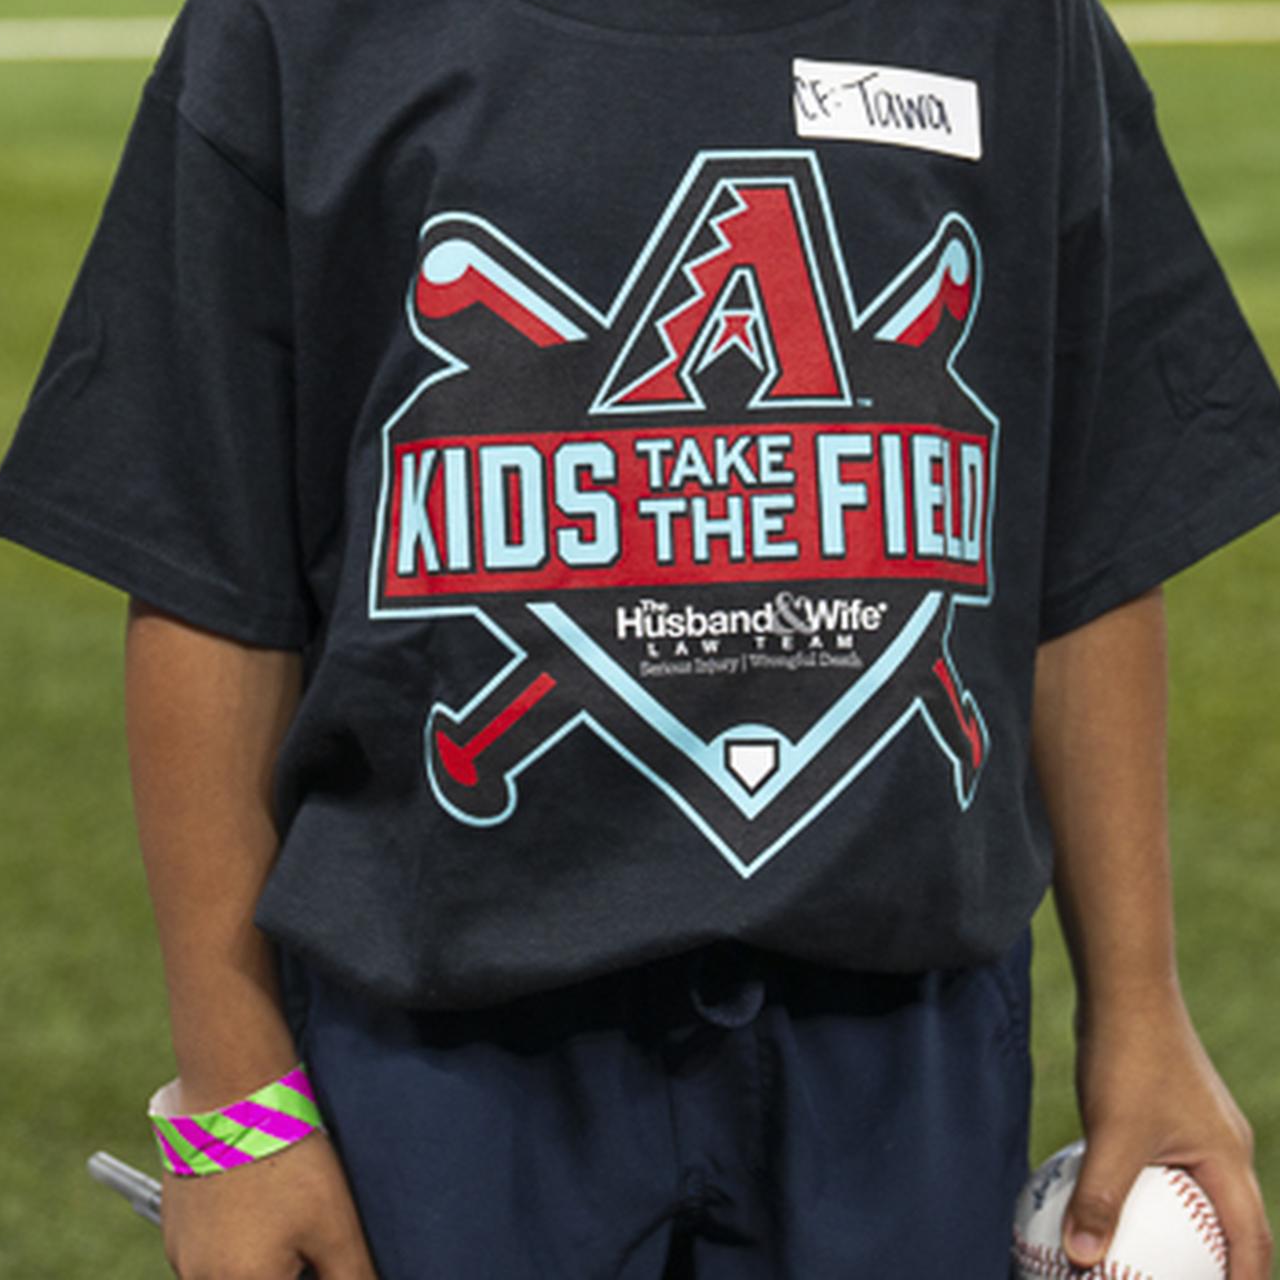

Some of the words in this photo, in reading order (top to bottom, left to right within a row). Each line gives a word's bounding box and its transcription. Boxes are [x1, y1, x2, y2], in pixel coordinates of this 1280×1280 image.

[841, 72, 952, 135] Tawa
[635, 434, 797, 488] TAKE
[396, 441, 619, 575] KIDS
[638, 493, 800, 563] THE
[817, 433, 984, 562] FIELD
[639, 598, 669, 612] The
[646, 638, 720, 658] LAW
[754, 633, 854, 651] TEAM
